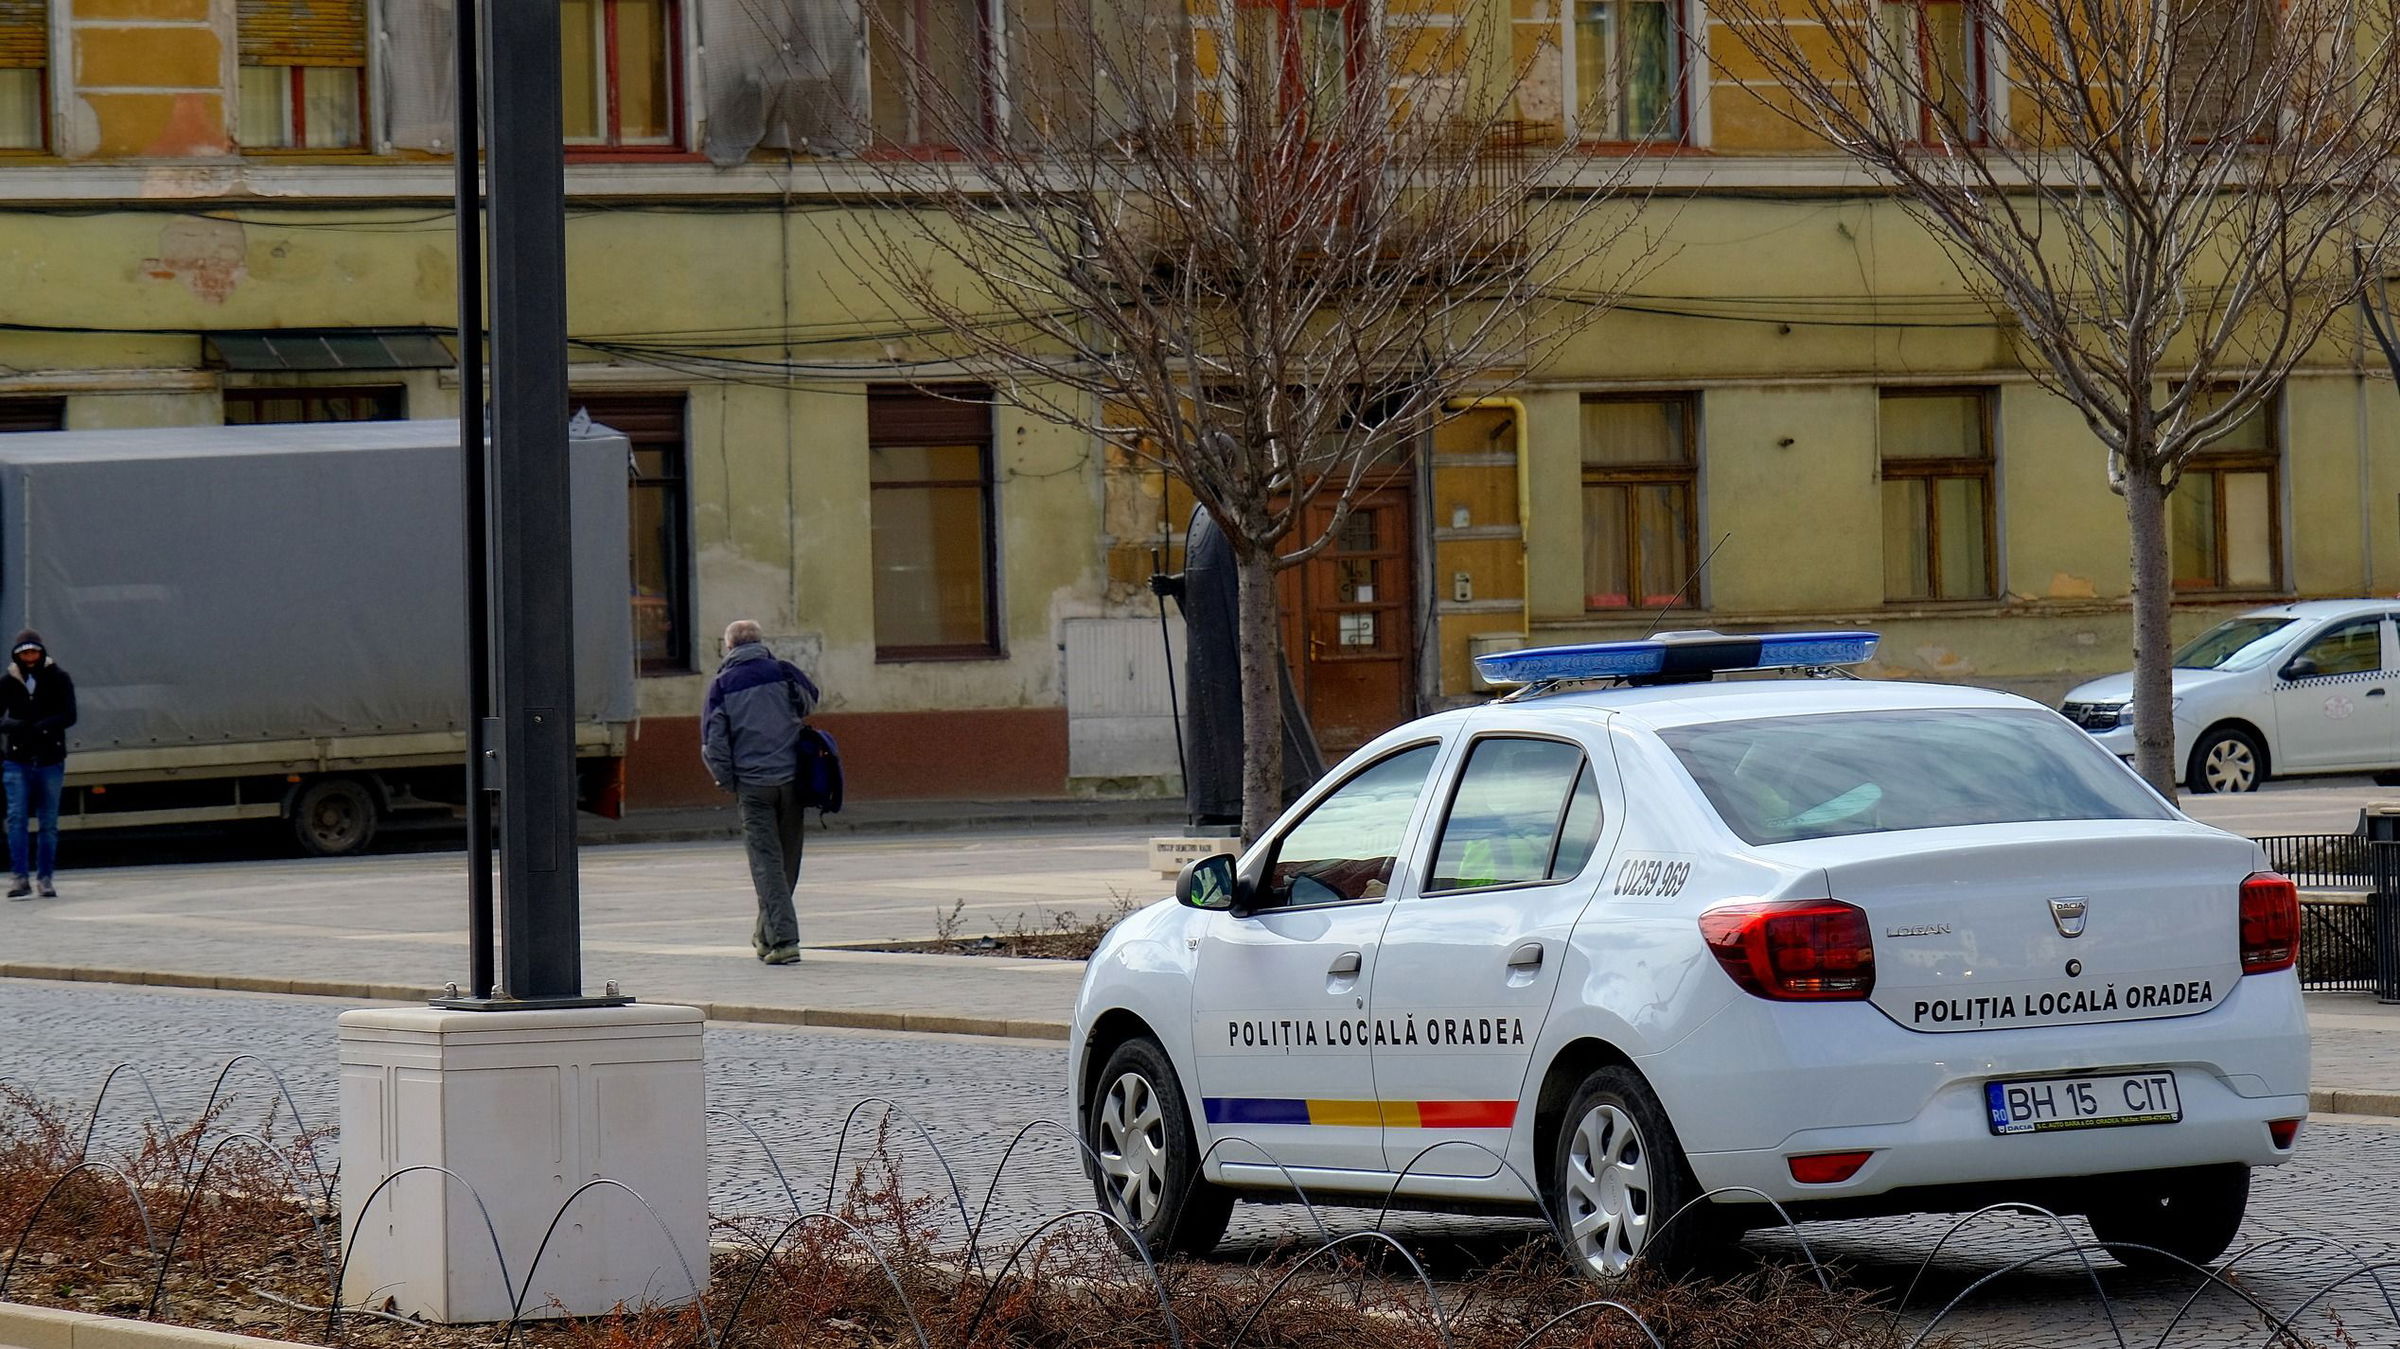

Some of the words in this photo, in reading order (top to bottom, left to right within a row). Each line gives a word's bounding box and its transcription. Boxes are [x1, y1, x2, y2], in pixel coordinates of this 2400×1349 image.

[1622, 859, 1662, 896] 0259
[1655, 861, 1691, 897] 969
[2056, 902, 2085, 910] DACIA
[1886, 923, 1951, 938] LOGAN
[2024, 983, 2118, 1017] LOCALĂ
[2126, 980, 2213, 1008] ORADEA
[1325, 1012, 1418, 1046] LOCALĂ
[1427, 1018, 1525, 1046] ORADEA
[2008, 1085, 2057, 1121] BH
[2066, 1082, 2098, 1116] 15
[2122, 1078, 2168, 1111] CIT
[1992, 1108, 2008, 1122] RO
[2007, 1124, 2033, 1132] DACIA
